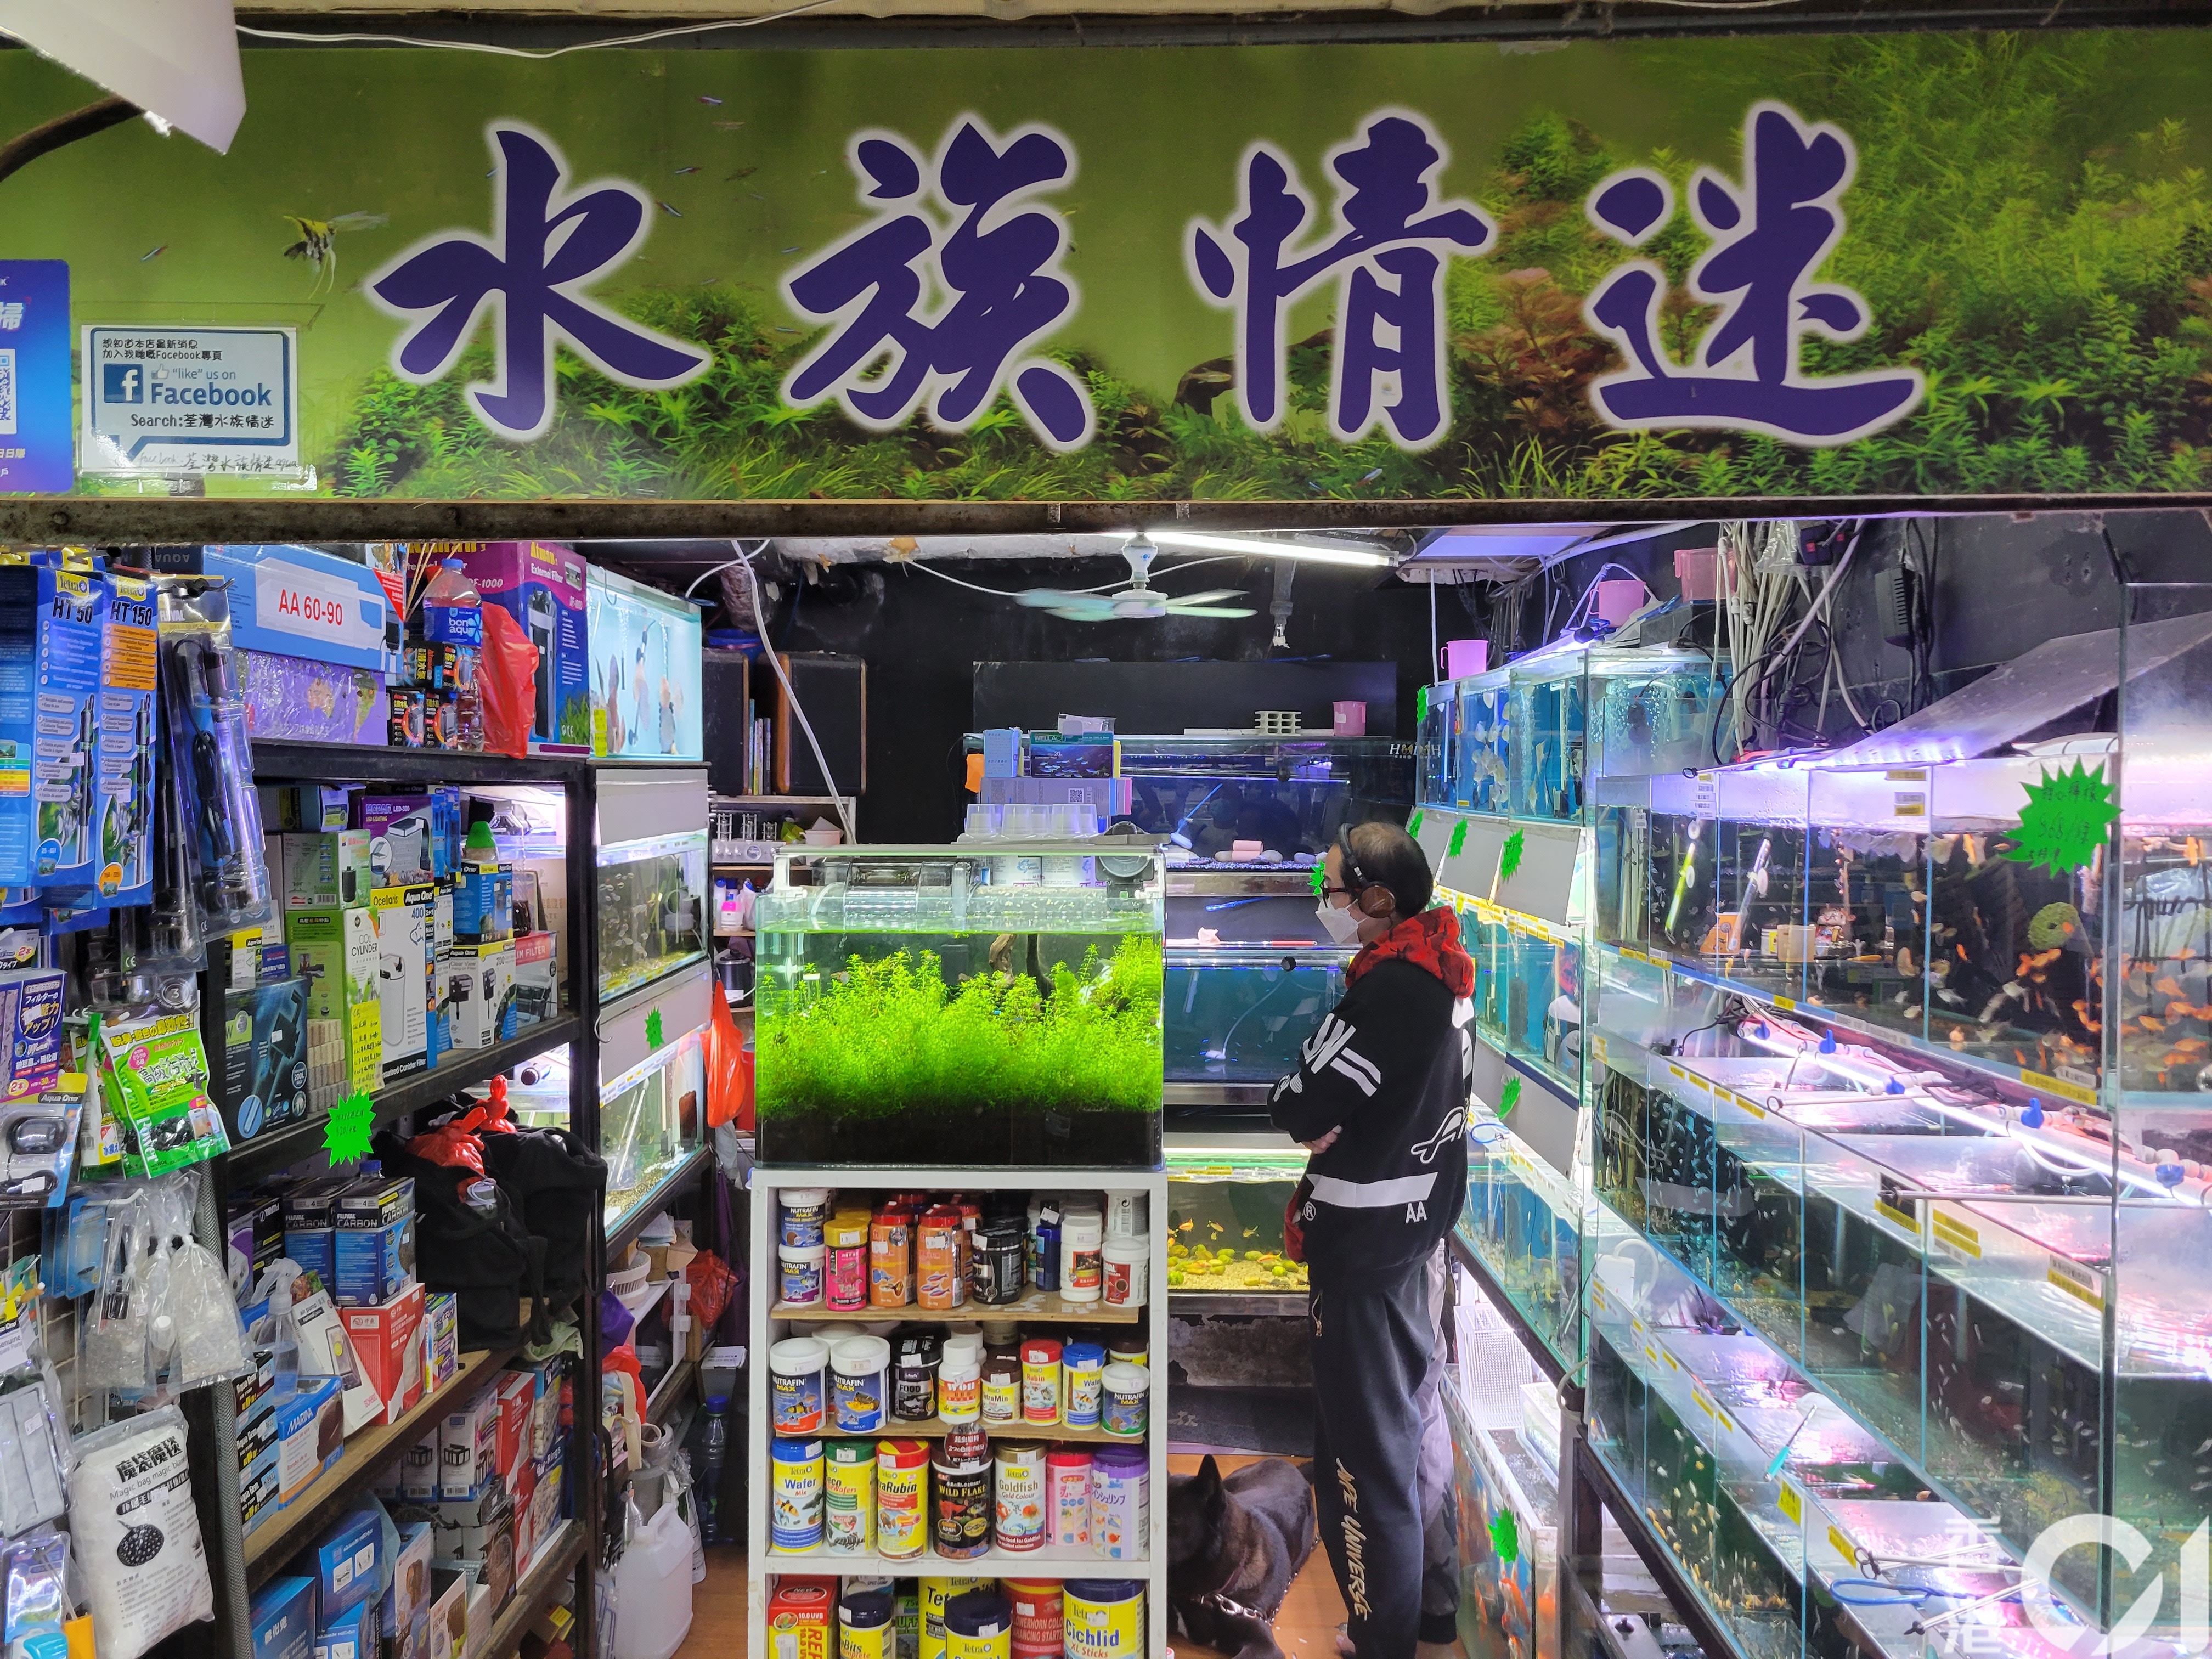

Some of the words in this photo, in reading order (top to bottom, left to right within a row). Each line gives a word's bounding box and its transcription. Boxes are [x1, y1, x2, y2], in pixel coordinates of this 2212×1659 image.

[374, 110, 1916, 442] 水族情迷
[103, 338, 198, 349] 想知道本店最新消息
[206, 371, 219, 380] us
[222, 371, 236, 380] on
[151, 382, 272, 407] Facebook
[531, 563, 550, 579] External
[551, 570, 563, 584] Filter
[58, 574, 79, 592] Tetra
[53, 596, 71, 620] HT
[76, 604, 93, 624] 50
[110, 600, 130, 623] HT
[132, 606, 153, 627] 150
[279, 589, 301, 622] AA
[304, 596, 343, 626] 60-90
[448, 618, 469, 627] bon
[374, 896, 398, 906] Ocellaris
[405, 891, 420, 904] Aqua
[421, 890, 433, 901] One
[411, 907, 424, 919] 400
[351, 943, 377, 957] CYLINDER
[526, 945, 546, 957] FILTER
[126, 956, 136, 967] CE
[25, 992, 59, 1005] フィルターの
[400, 1059, 416, 1074] Canister
[416, 1058, 426, 1069] Filter
[294, 1073, 304, 1081] 200L
[41, 1094, 63, 1103] Aqua
[64, 1093, 78, 1102] One
[382, 1205, 409, 1224] CARBON
[1406, 1201, 1427, 1223] AA
[285, 1219, 328, 1229] CARBON
[337, 1218, 377, 1228] CARBON
[236, 1380, 247, 1394] Aqua
[247, 1373, 257, 1385] Gem
[1026, 1373, 1045, 1382] Rubin
[776, 1384, 796, 1392] MAX
[837, 1384, 855, 1392] MAX
[287, 1407, 313, 1436] MARINA
[236, 1436, 248, 1449] Aqua
[247, 1427, 257, 1439] Gem
[115, 1435, 183, 1483] 魔袋魔毯
[789, 1466, 806, 1475] Tetra
[1006, 1469, 1022, 1478] Tetra
[110, 1482, 136, 1500] Magic
[137, 1475, 151, 1488] bag
[153, 1465, 172, 1480] magic
[251, 1481, 259, 1494] Gem
[785, 1477, 817, 1489] Wafer
[998, 1479, 1038, 1492] Goldfish
[939, 1484, 959, 1497] WILD
[961, 1484, 986, 1497] FLAKE
[1024, 1534, 1041, 1543] Goldfish
[1341, 1514, 1373, 1621] UNIVERSE
[1065, 1617, 1119, 1647] Cichlid
[963, 1643, 983, 1654] Tetra
[1071, 1642, 1079, 1653] XL
[1081, 1645, 1108, 1658] Sticks
